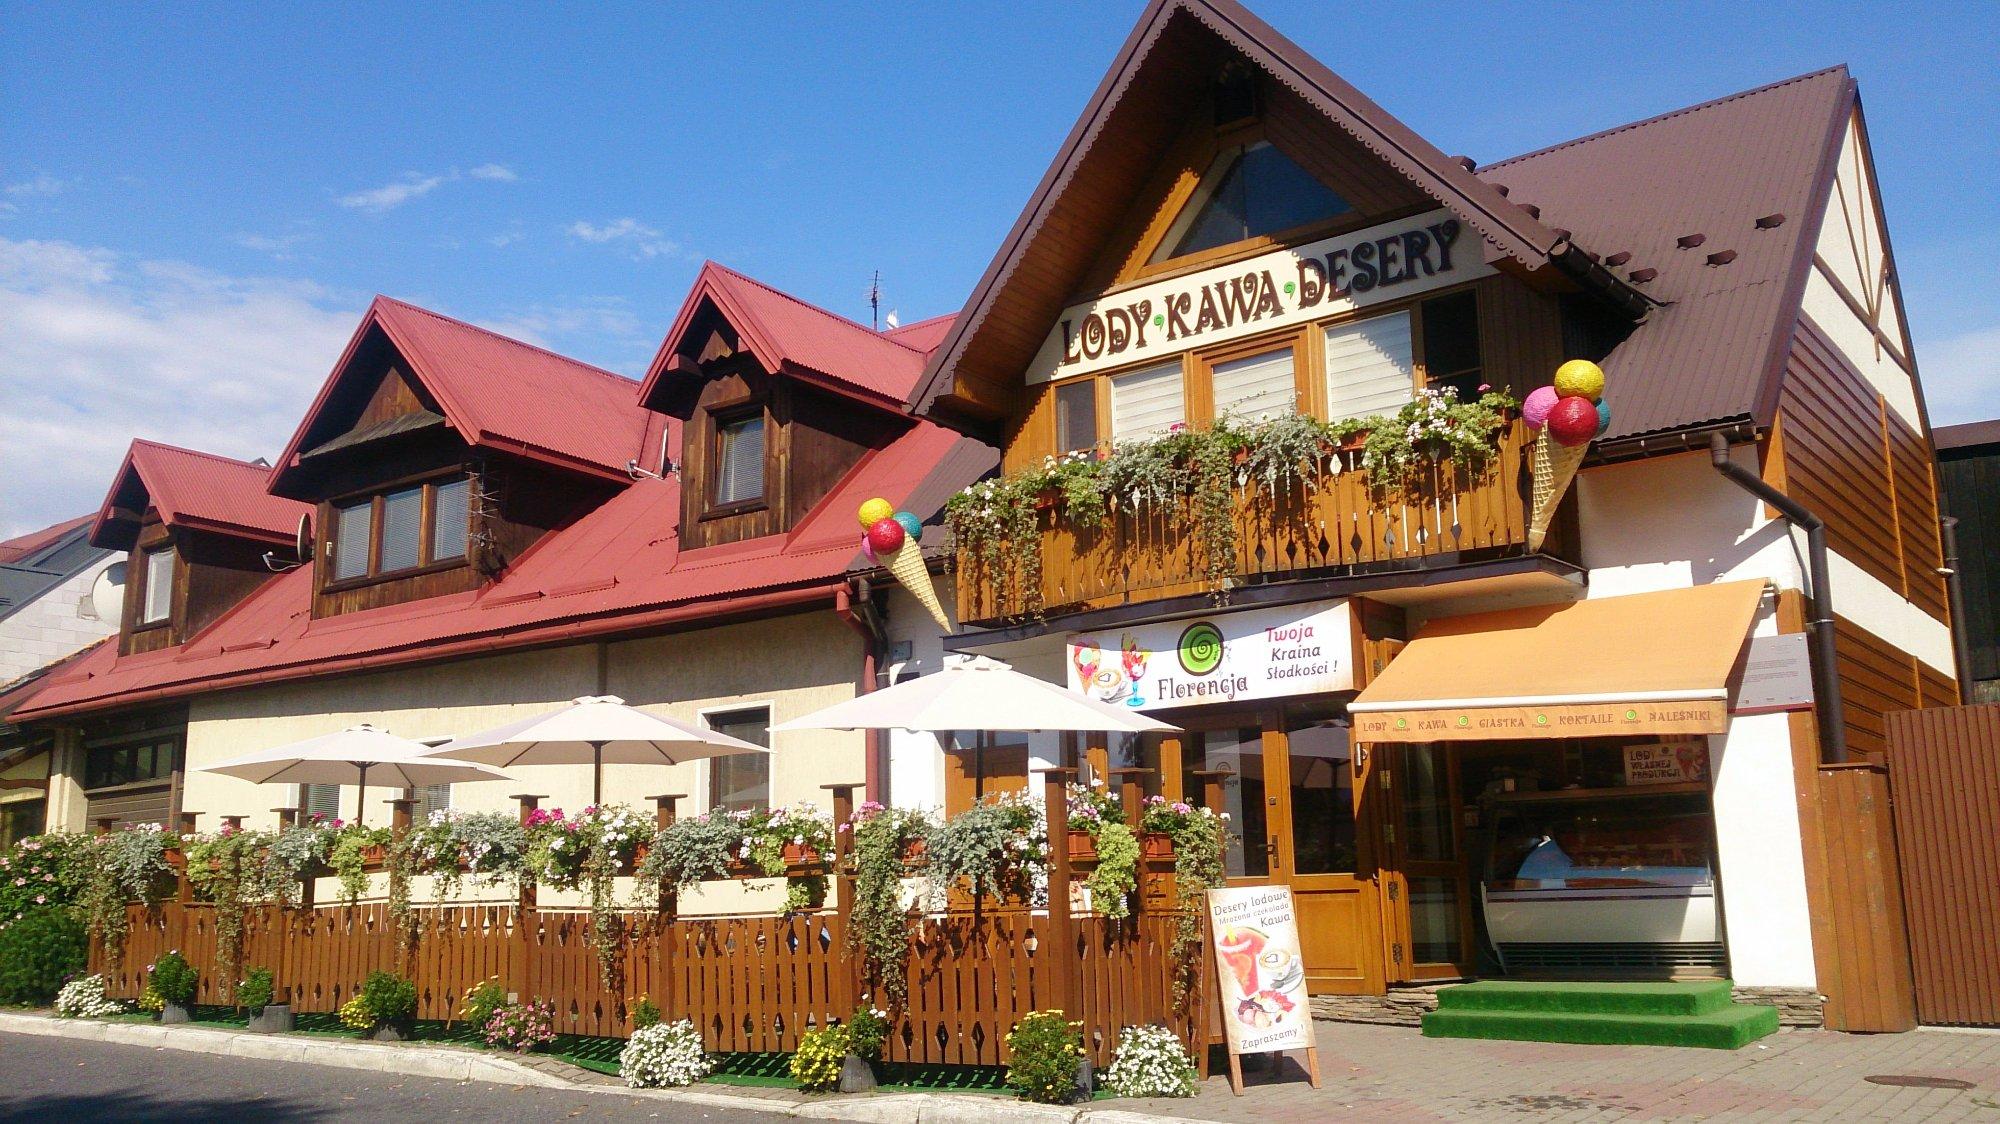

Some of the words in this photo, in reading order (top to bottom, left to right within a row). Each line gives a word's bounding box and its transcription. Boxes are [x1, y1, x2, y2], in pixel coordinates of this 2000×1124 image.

[1061, 299, 1152, 366] LODY
[1164, 269, 1285, 342] KAWA
[1296, 219, 1460, 310] DESERY
[1265, 623, 1314, 644] Twoja
[1271, 644, 1321, 662] Kraina
[1266, 663, 1328, 680] Słodkości
[1158, 674, 1248, 701] Florencja
[1363, 721, 1387, 732] LODY
[1418, 719, 1448, 730] KAWA
[1213, 901, 1248, 916] Desery
[1251, 891, 1288, 907] lodowe
[1260, 913, 1291, 928] Kawa
[1241, 1028, 1298, 1049] Zapraszamy
